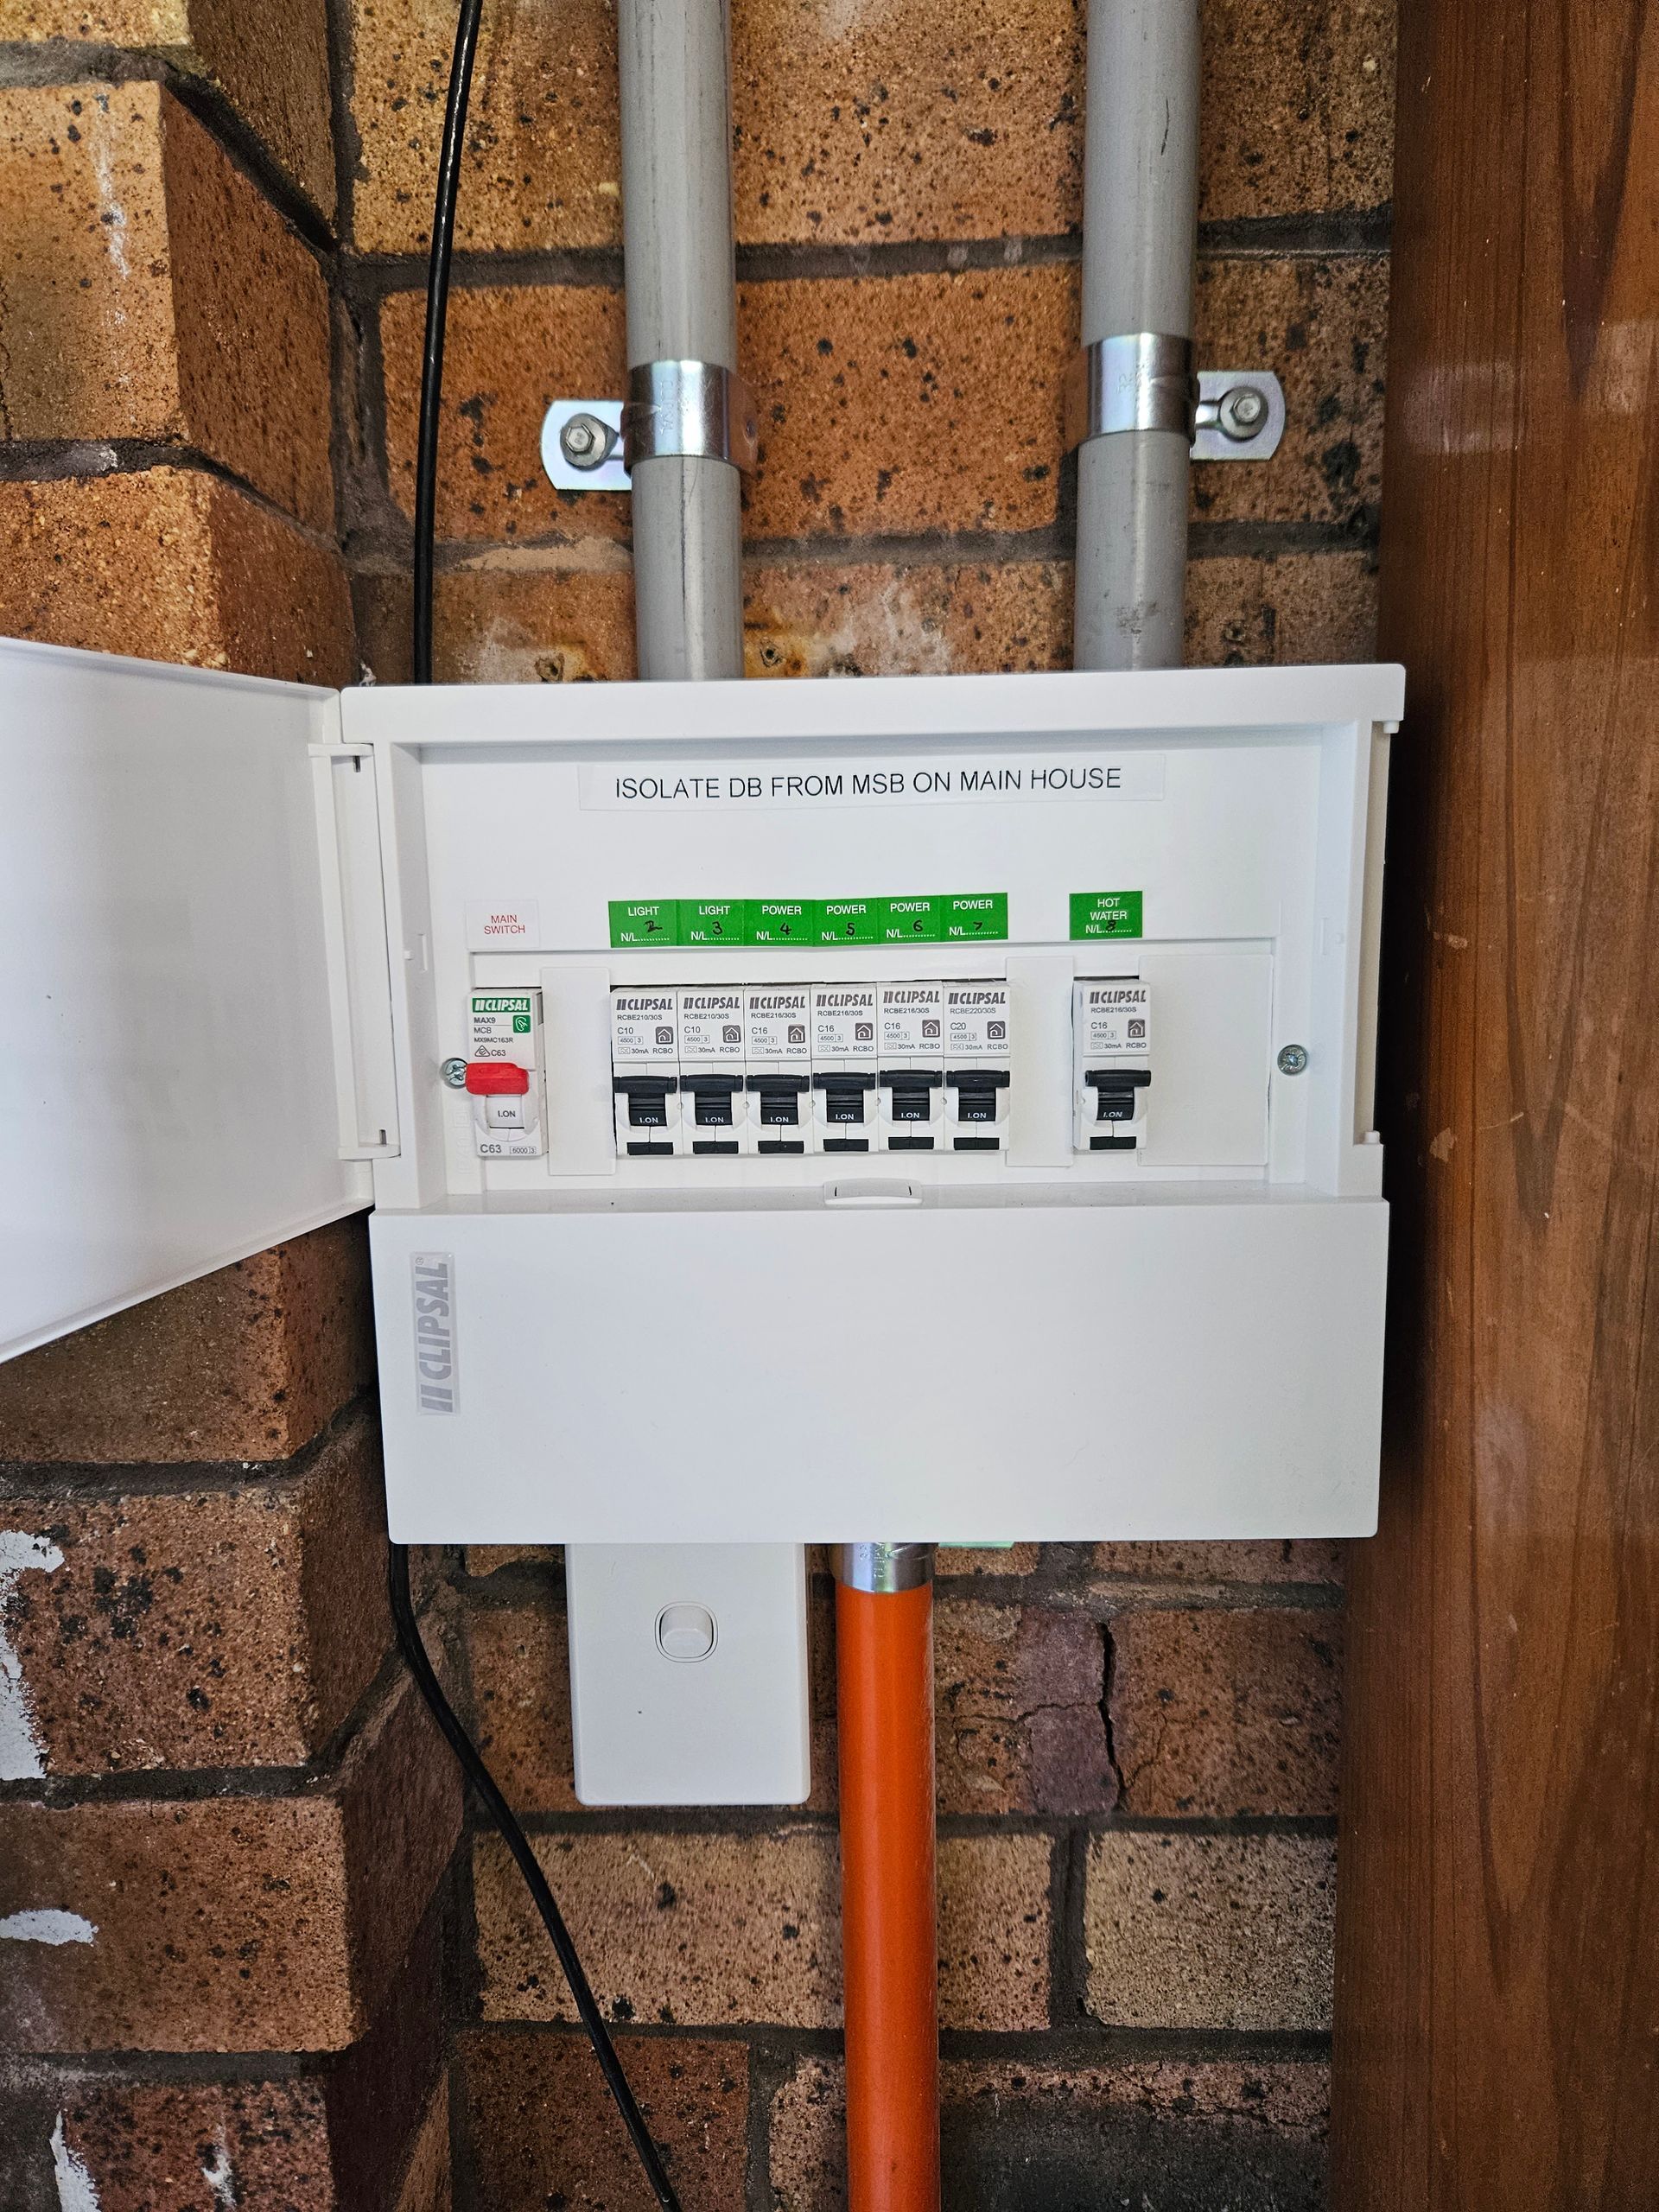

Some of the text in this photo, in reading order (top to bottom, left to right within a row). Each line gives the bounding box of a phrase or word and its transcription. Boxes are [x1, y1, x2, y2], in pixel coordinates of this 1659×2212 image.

[615, 767, 1122, 798] ISOLATE DB FROM MSB ON MAIN HOUSE
[890, 902, 930, 912] POWER
[952, 899, 993, 910] POWER
[1097, 898, 1120, 907] HOT
[627, 906, 659, 916] LIGHT
[698, 906, 731, 915] LIGHT
[762, 906, 802, 915] POWER
[826, 905, 866, 915] POWER
[1090, 911, 1128, 921] WATER
[491, 914, 517, 924] MAIN
[1106, 919, 1116, 931] 8
[484, 925, 525, 935] SWITCH
[712, 921, 722, 935] 3
[779, 923, 792, 935] 4
[845, 923, 855, 935] 5
[912, 919, 923, 932] 6
[973, 921, 983, 931] 7
[695, 996, 740, 1009] CLIPSAL
[760, 995, 805, 1009] CLIPSAL
[827, 994, 873, 1007] CLIPSAL
[893, 990, 940, 1004] CLIPSAL
[959, 992, 1006, 1005] CLIPSAL
[1100, 990, 1146, 1004] CLIPSAL
[485, 998, 529, 1012] CLIPSAL
[627, 998, 673, 1011] CLIPSAL
[480, 1144, 501, 1154] C63
[415, 1262, 452, 1381] CLIPSAL
